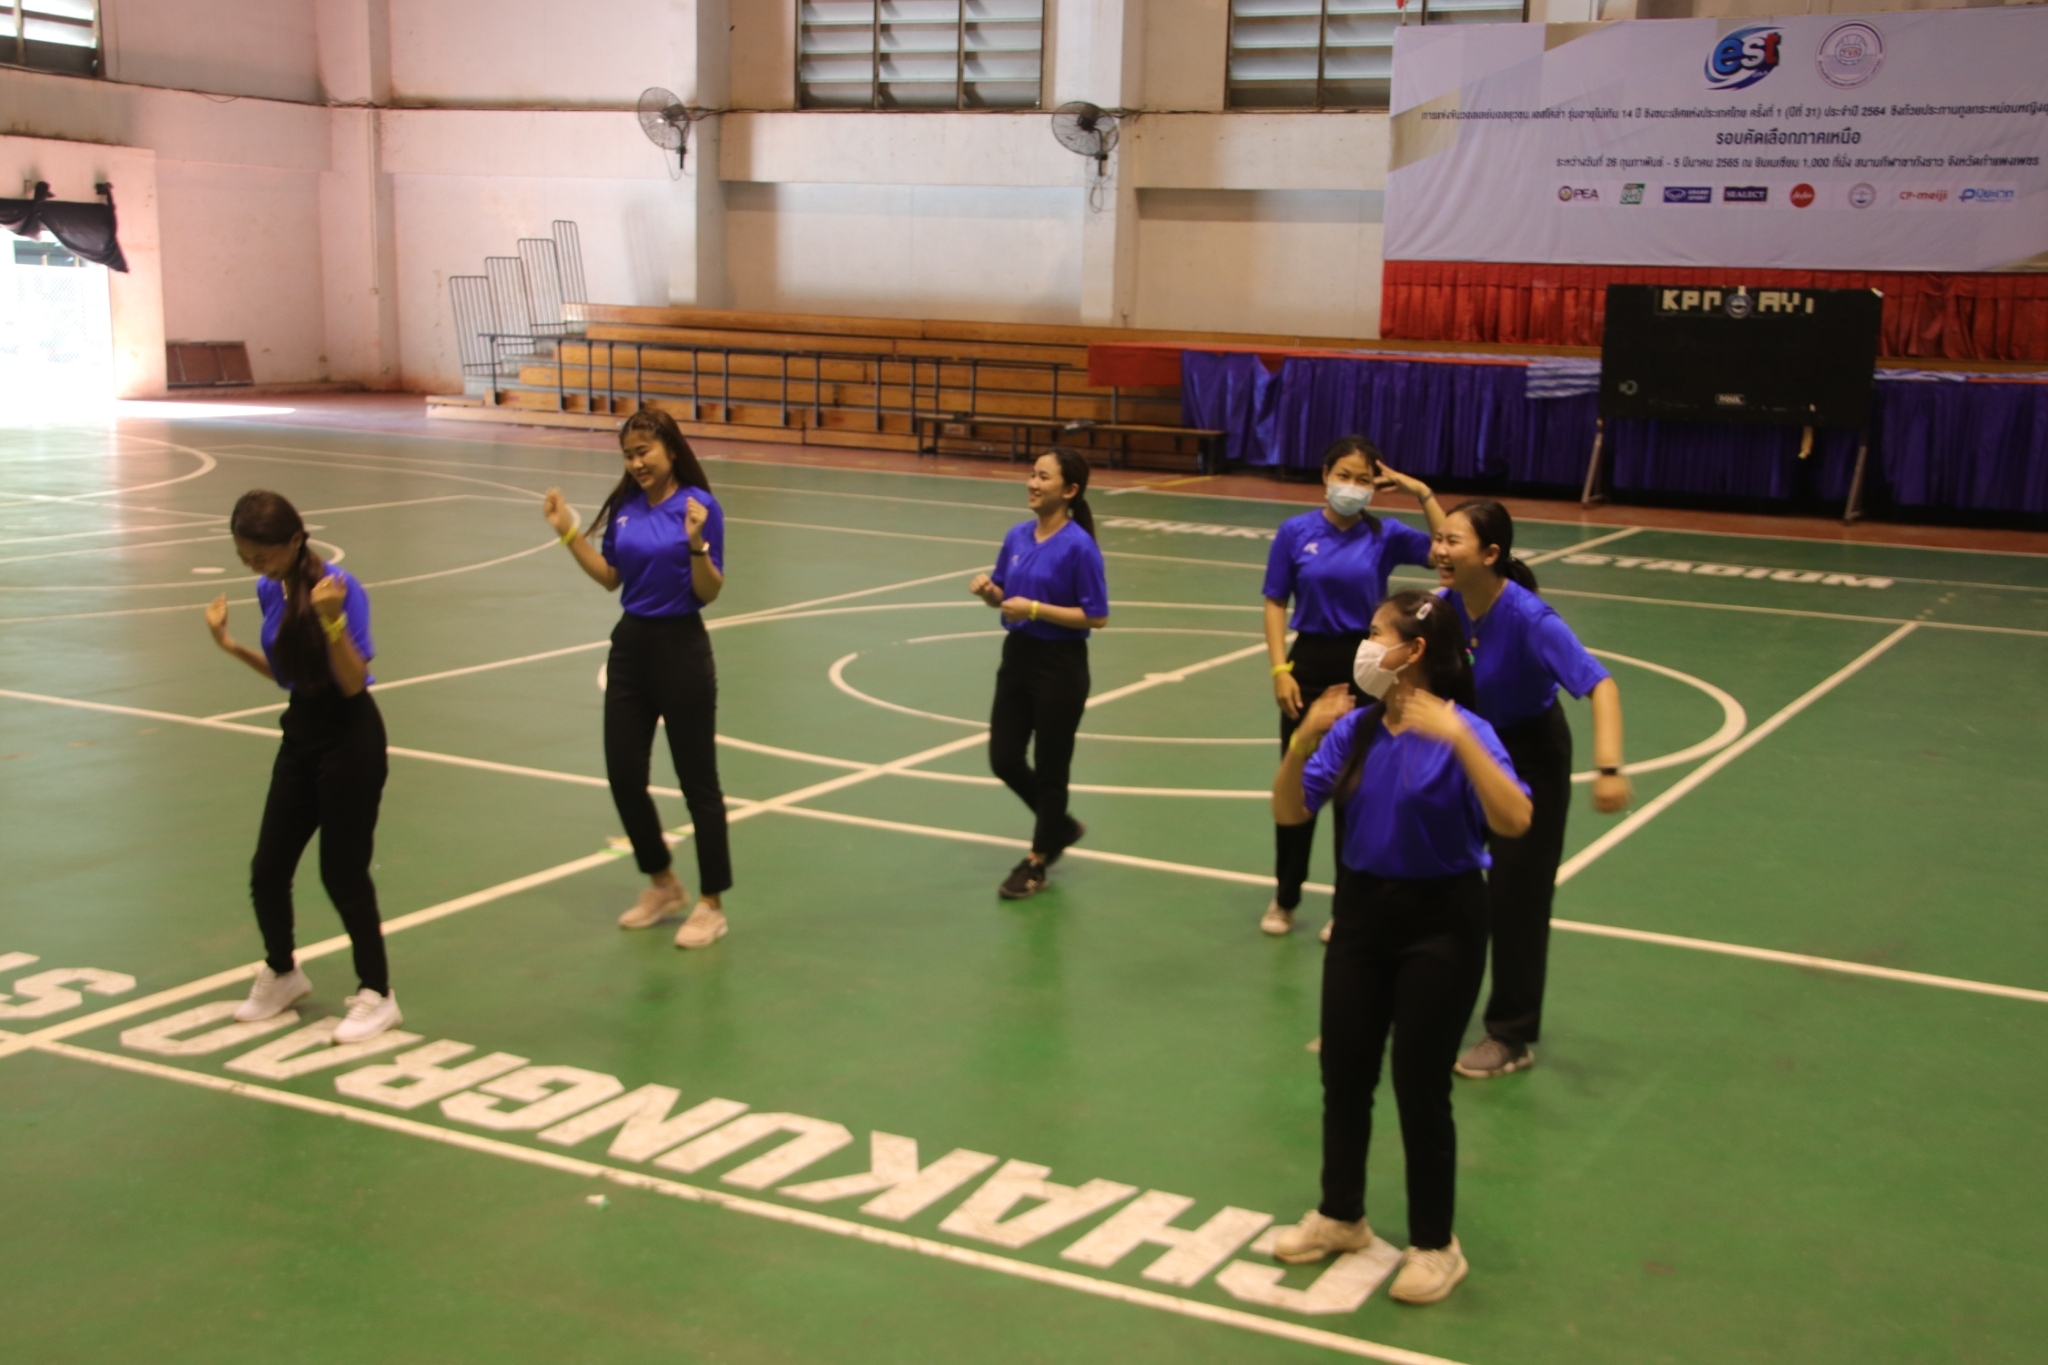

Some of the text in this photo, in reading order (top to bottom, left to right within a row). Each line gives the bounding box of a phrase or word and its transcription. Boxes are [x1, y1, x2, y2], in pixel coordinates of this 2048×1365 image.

[1713, 32, 1781, 76] est
[1622, 109, 1633, 118] 14
[1861, 106, 1885, 116] 2564
[1716, 127, 1861, 145] รอบคัดเลือกภาคเหนือ
[1573, 188, 1599, 200] PEA
[1725, 190, 1767, 199] SEALECT
[1560, 553, 1895, 590] STADIUM
